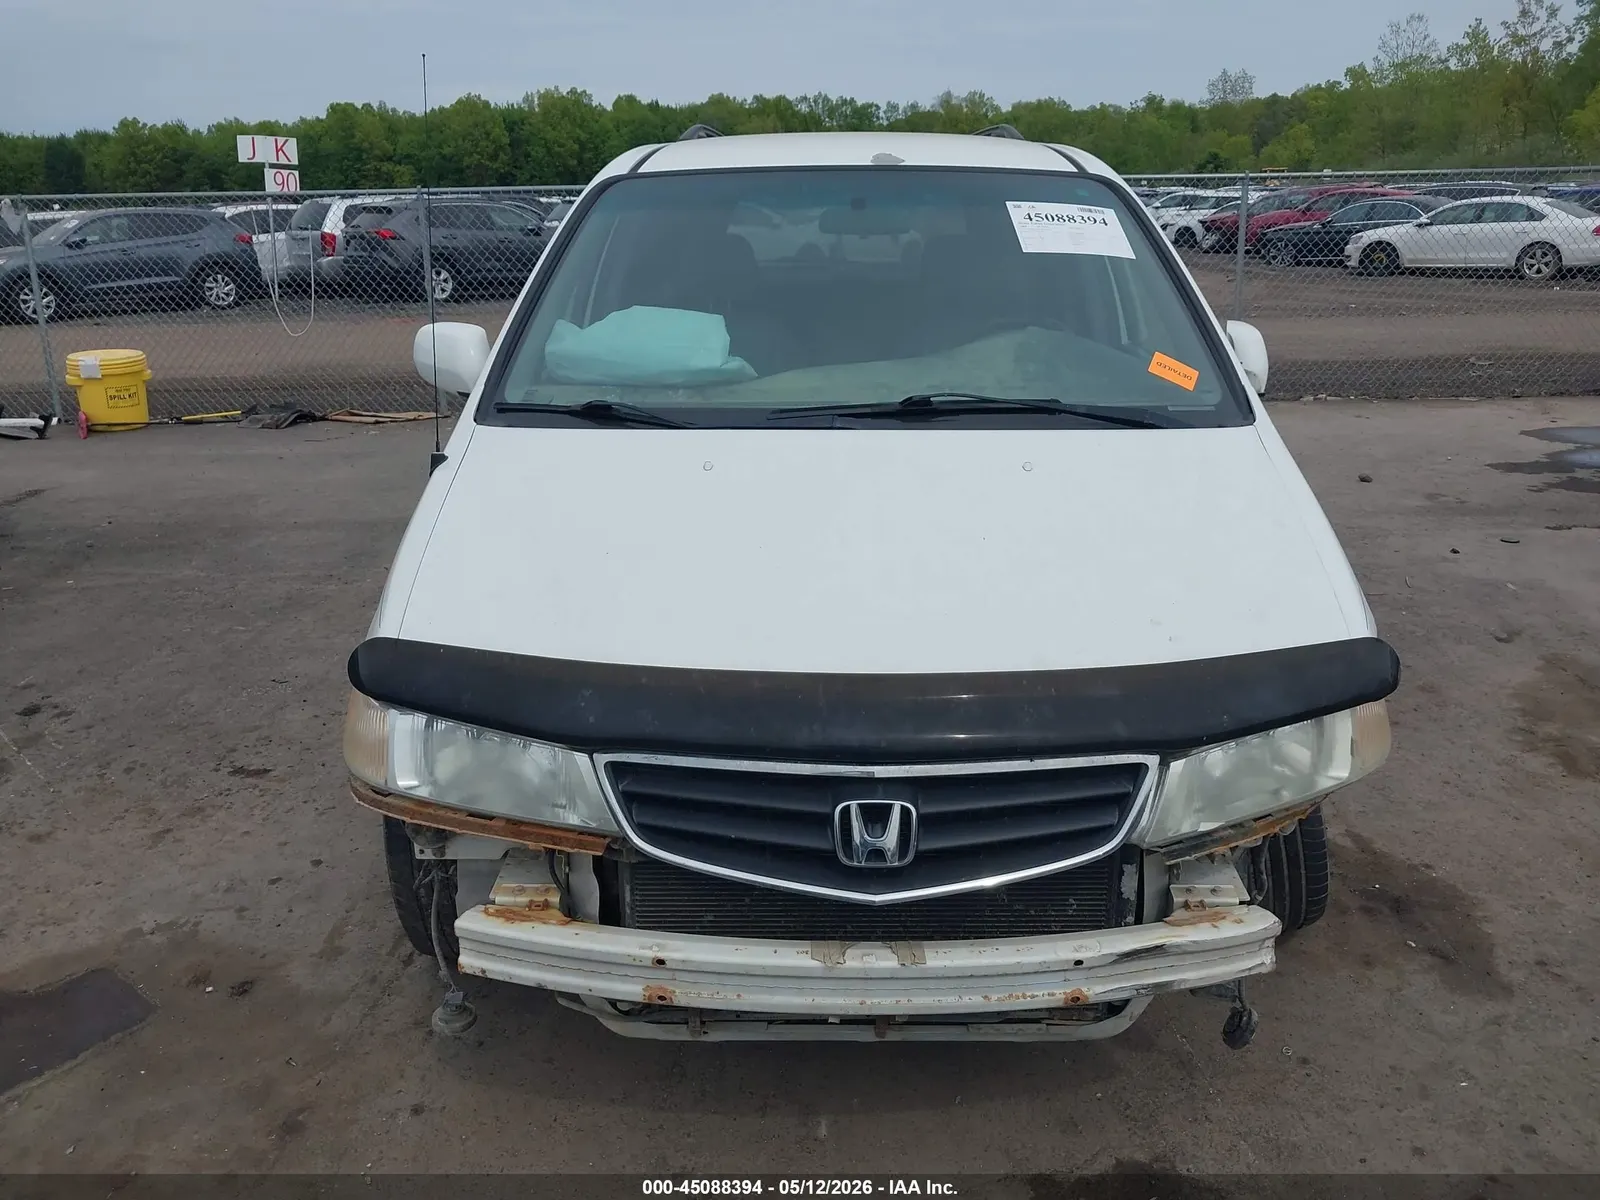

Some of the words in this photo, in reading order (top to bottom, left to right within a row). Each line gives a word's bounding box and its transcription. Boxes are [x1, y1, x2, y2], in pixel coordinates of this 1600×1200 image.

[246, 136, 256, 161] J
[273, 137, 292, 163] K
[273, 171, 298, 192] 90
[1023, 211, 1108, 227] 45088394
[1156, 361, 1193, 381] DETAILED
[128, 391, 138, 399] KIT
